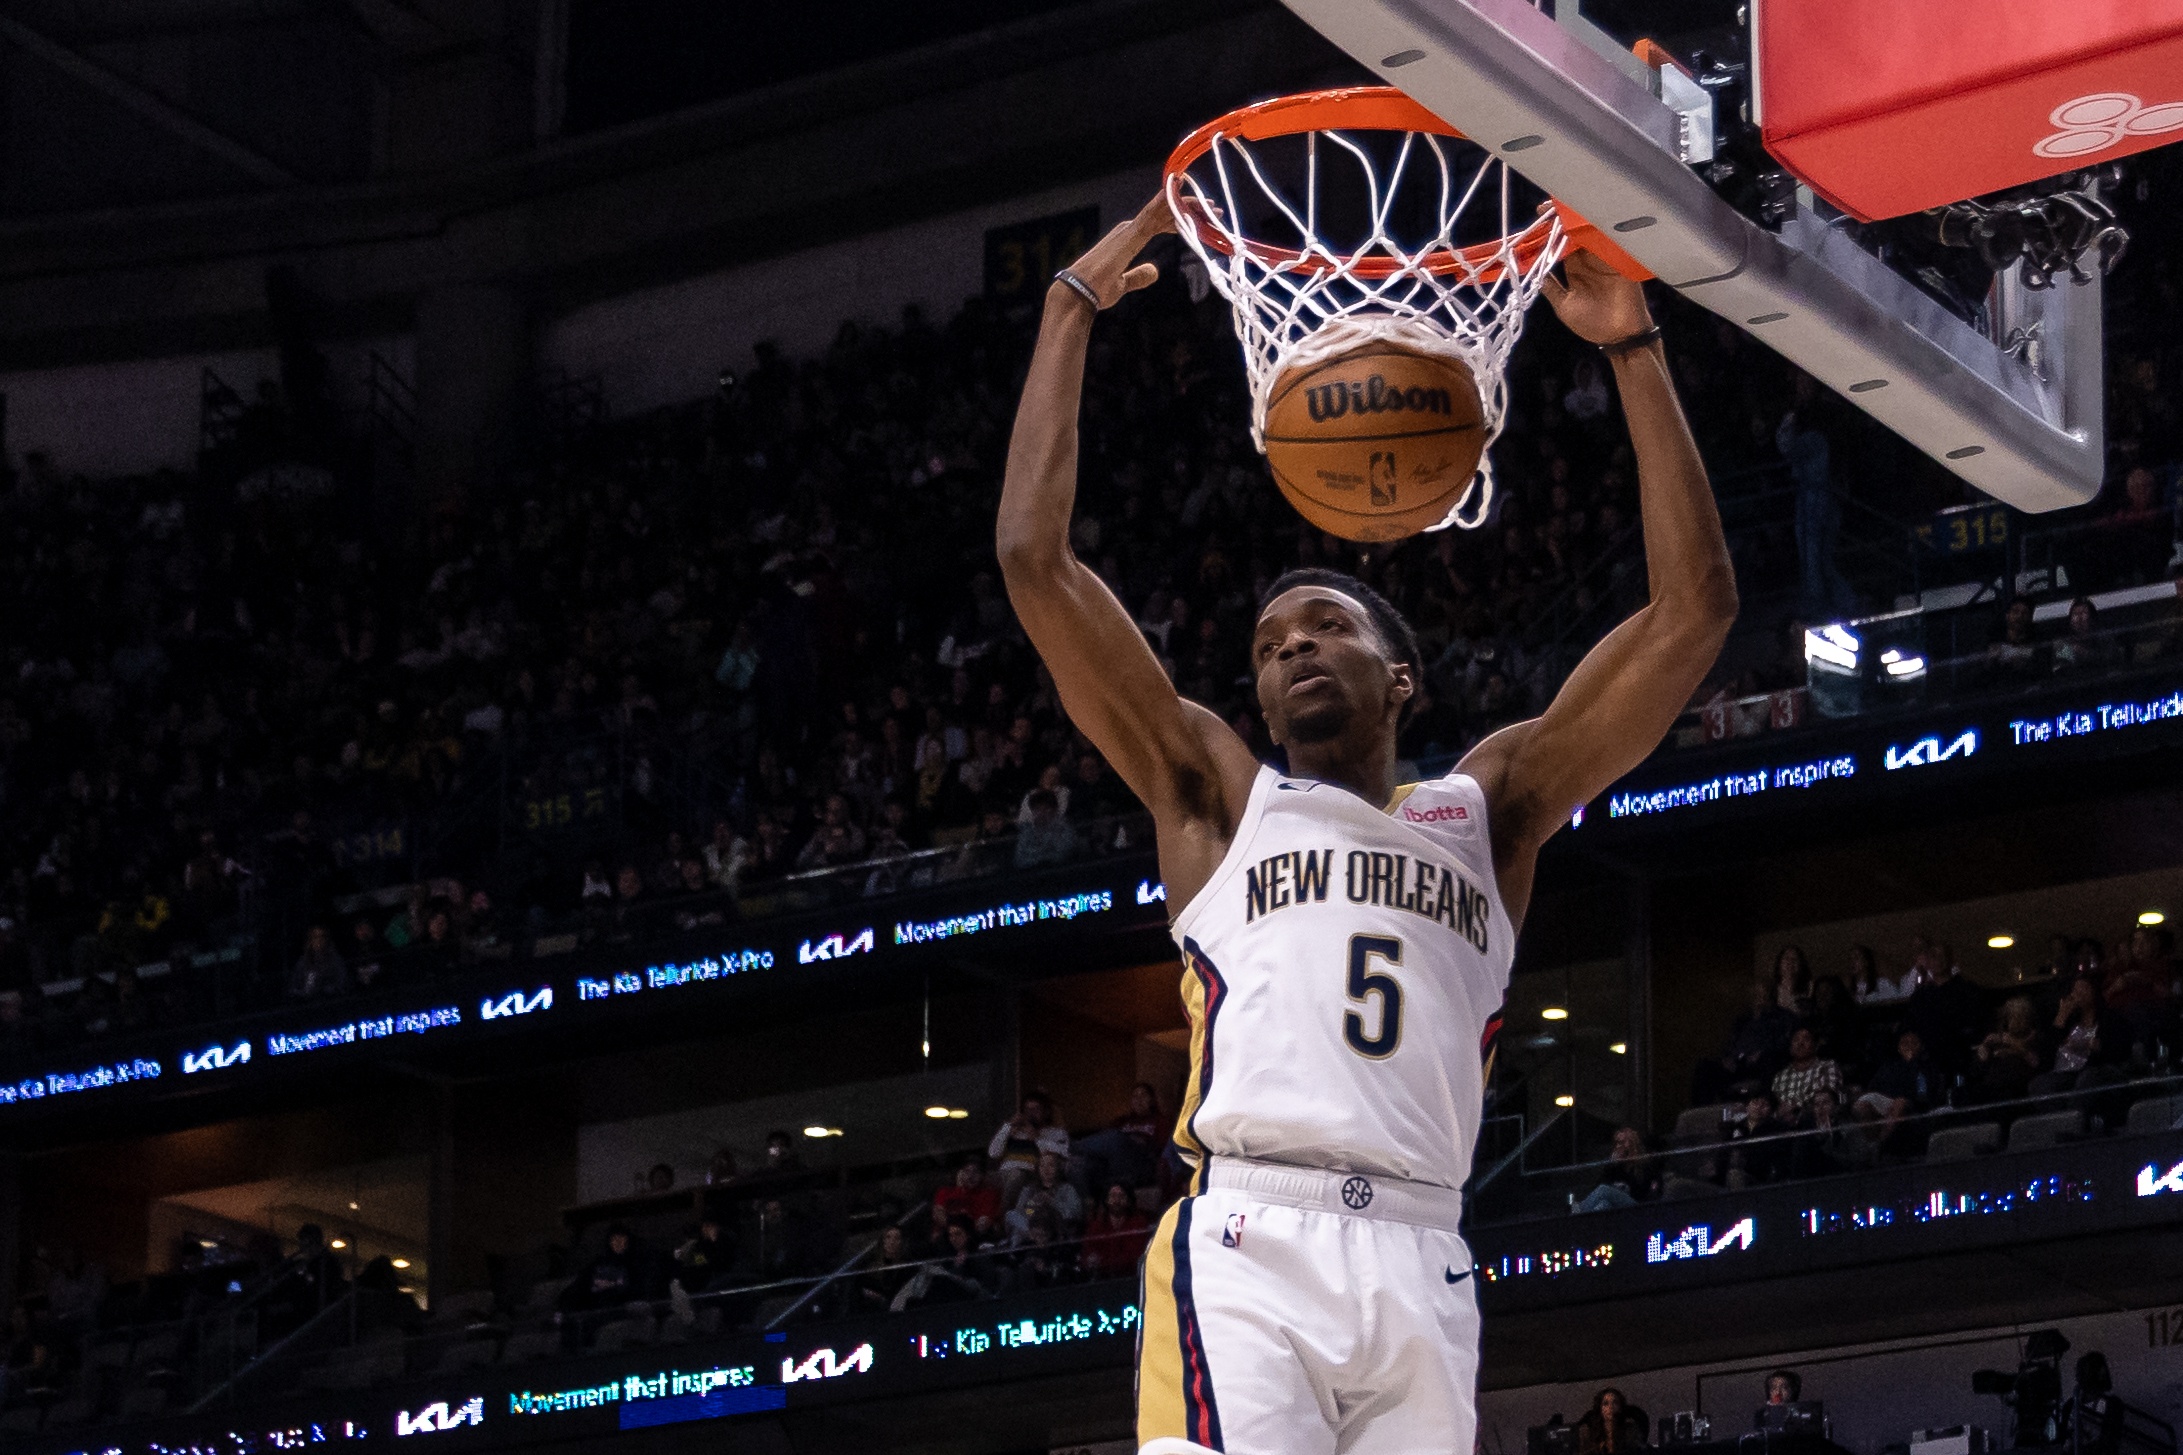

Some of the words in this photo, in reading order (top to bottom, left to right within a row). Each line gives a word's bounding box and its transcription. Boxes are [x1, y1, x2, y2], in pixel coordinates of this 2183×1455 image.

[1306, 374, 1452, 423] Wilson
[1950, 512, 2009, 550] 315
[1610, 779, 1720, 817] Movement
[1725, 771, 1767, 796] that
[1775, 757, 1854, 787] inspires
[1884, 731, 1976, 770] KIA
[2010, 721, 2051, 744] The
[2057, 713, 2093, 736] Kia
[2097, 692, 2183, 729] Tellurid
[1404, 804, 1469, 824] ibotta
[1245, 849, 1334, 926] NEW
[1345, 849, 1490, 957] ORLEANS
[183, 1041, 251, 1073] KIA
[271, 1024, 356, 1055] Movement
[359, 1017, 393, 1039] that
[397, 1007, 461, 1033] inspires
[481, 988, 553, 1019] KIA
[577, 979, 610, 1000] The
[614, 974, 641, 993] Kia
[647, 958, 719, 988] Telluride
[799, 928, 873, 964] KIA
[896, 912, 995, 944] Movement
[997, 902, 1035, 926] that
[1039, 891, 1111, 919] inspires
[1342, 931, 1405, 1061] 5
[511, 1382, 619, 1414] Movement
[624, 1373, 668, 1401] that
[672, 1366, 754, 1397] inspires
[782, 1344, 873, 1383] KIA
[957, 1329, 989, 1354] Kia
